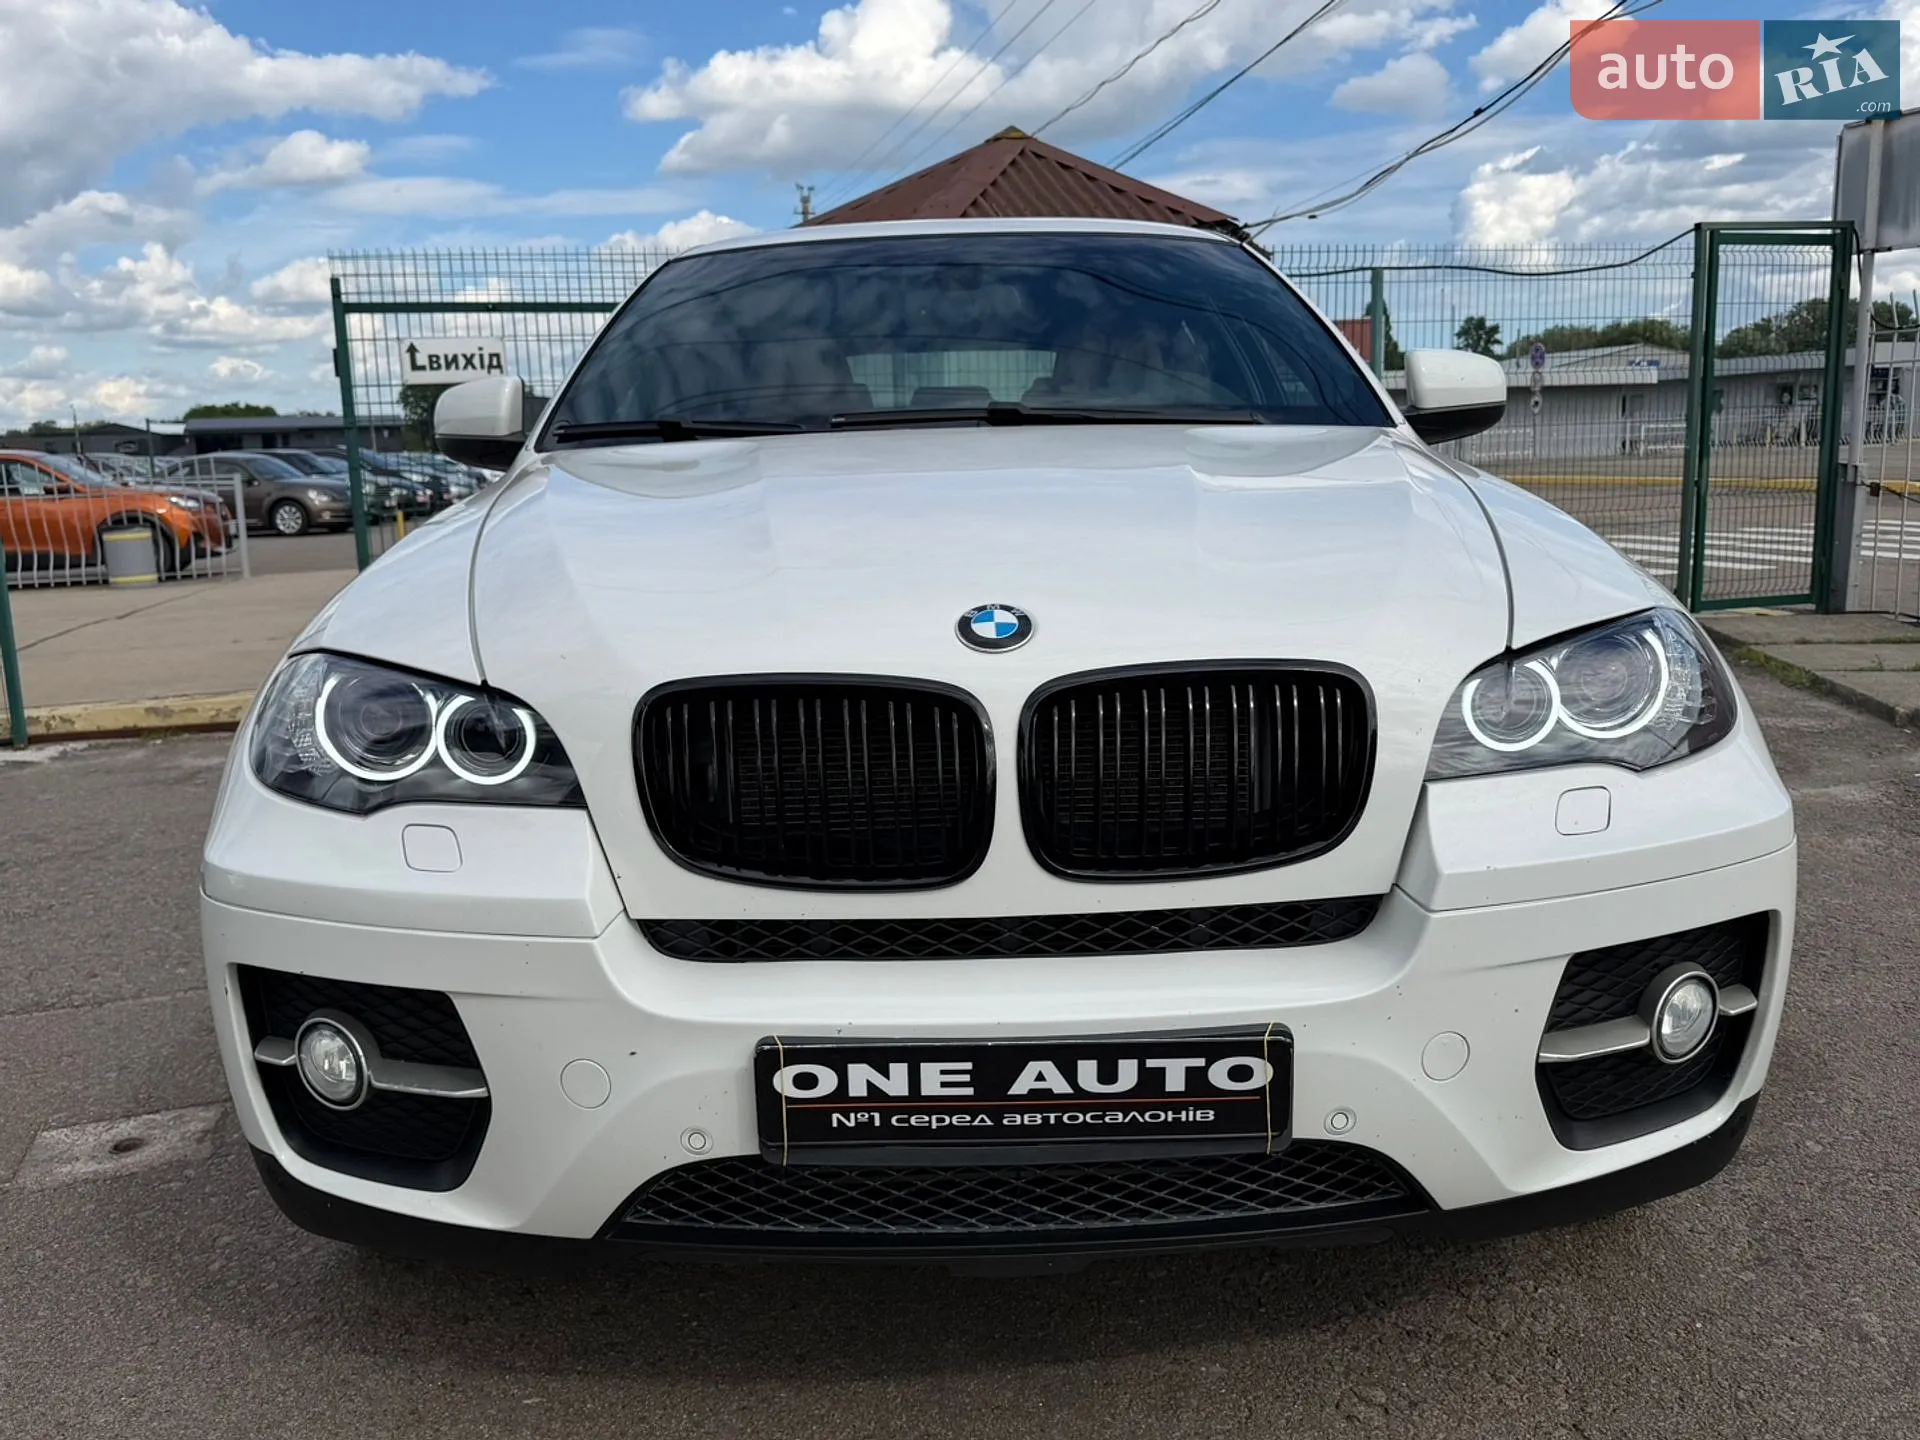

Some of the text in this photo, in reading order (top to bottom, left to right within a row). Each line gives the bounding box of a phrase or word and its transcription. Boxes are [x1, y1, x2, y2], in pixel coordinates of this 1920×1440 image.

[427, 346, 504, 375] вихід
[773, 1056, 1274, 1098] ONE AUTO
[891, 1113, 994, 1129] серед
[1002, 1106, 1215, 1126] автосалонів
